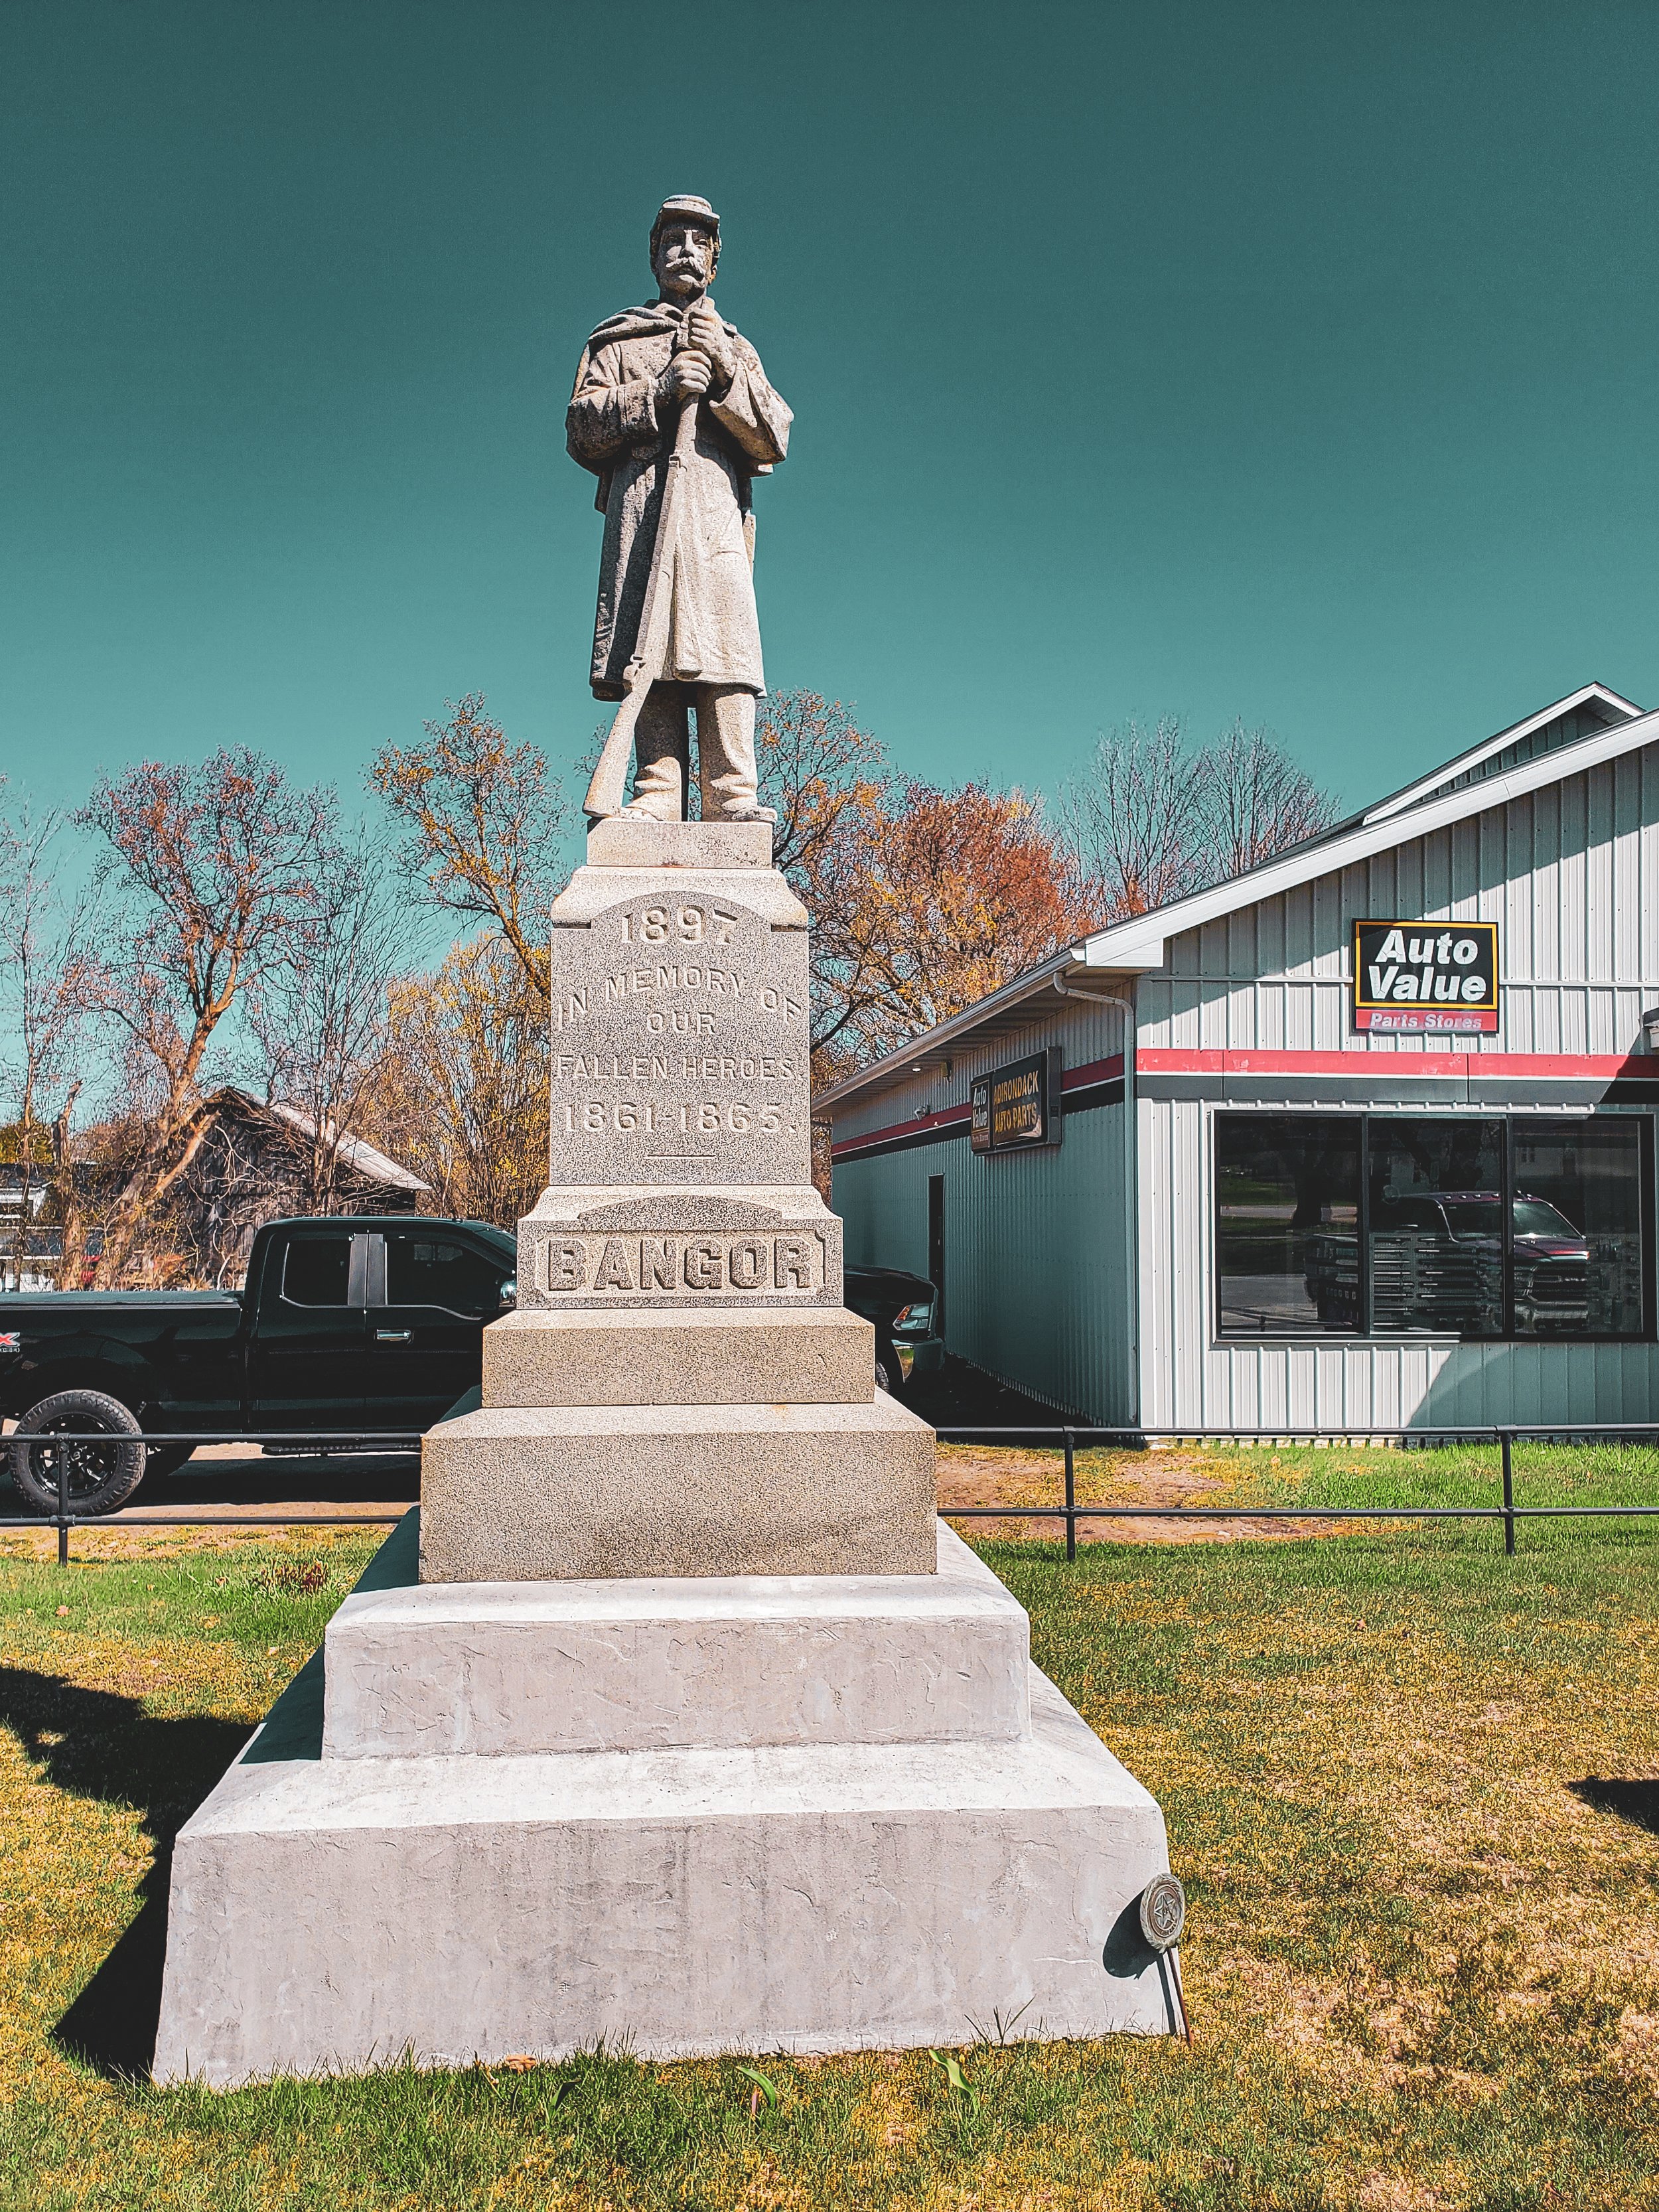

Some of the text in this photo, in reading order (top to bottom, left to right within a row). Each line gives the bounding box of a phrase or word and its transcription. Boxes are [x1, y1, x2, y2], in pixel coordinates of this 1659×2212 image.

[621, 905, 739, 945] 1897
[1374, 929, 1479, 965] Auto
[558, 965, 802, 1032] IN MEMORY OF
[1368, 965, 1486, 1001] Value
[646, 1011, 717, 1035] OUR
[1370, 1013, 1482, 1029] Parts Stores
[555, 1055, 668, 1080] FALLEN
[973, 1085, 987, 1108] Auto
[993, 1070, 1039, 1106] ADIRONDACK
[972, 1107, 987, 1129] Value
[995, 1102, 1037, 1134] AUTO PARTS
[547, 1236, 812, 1291] BANGOR
